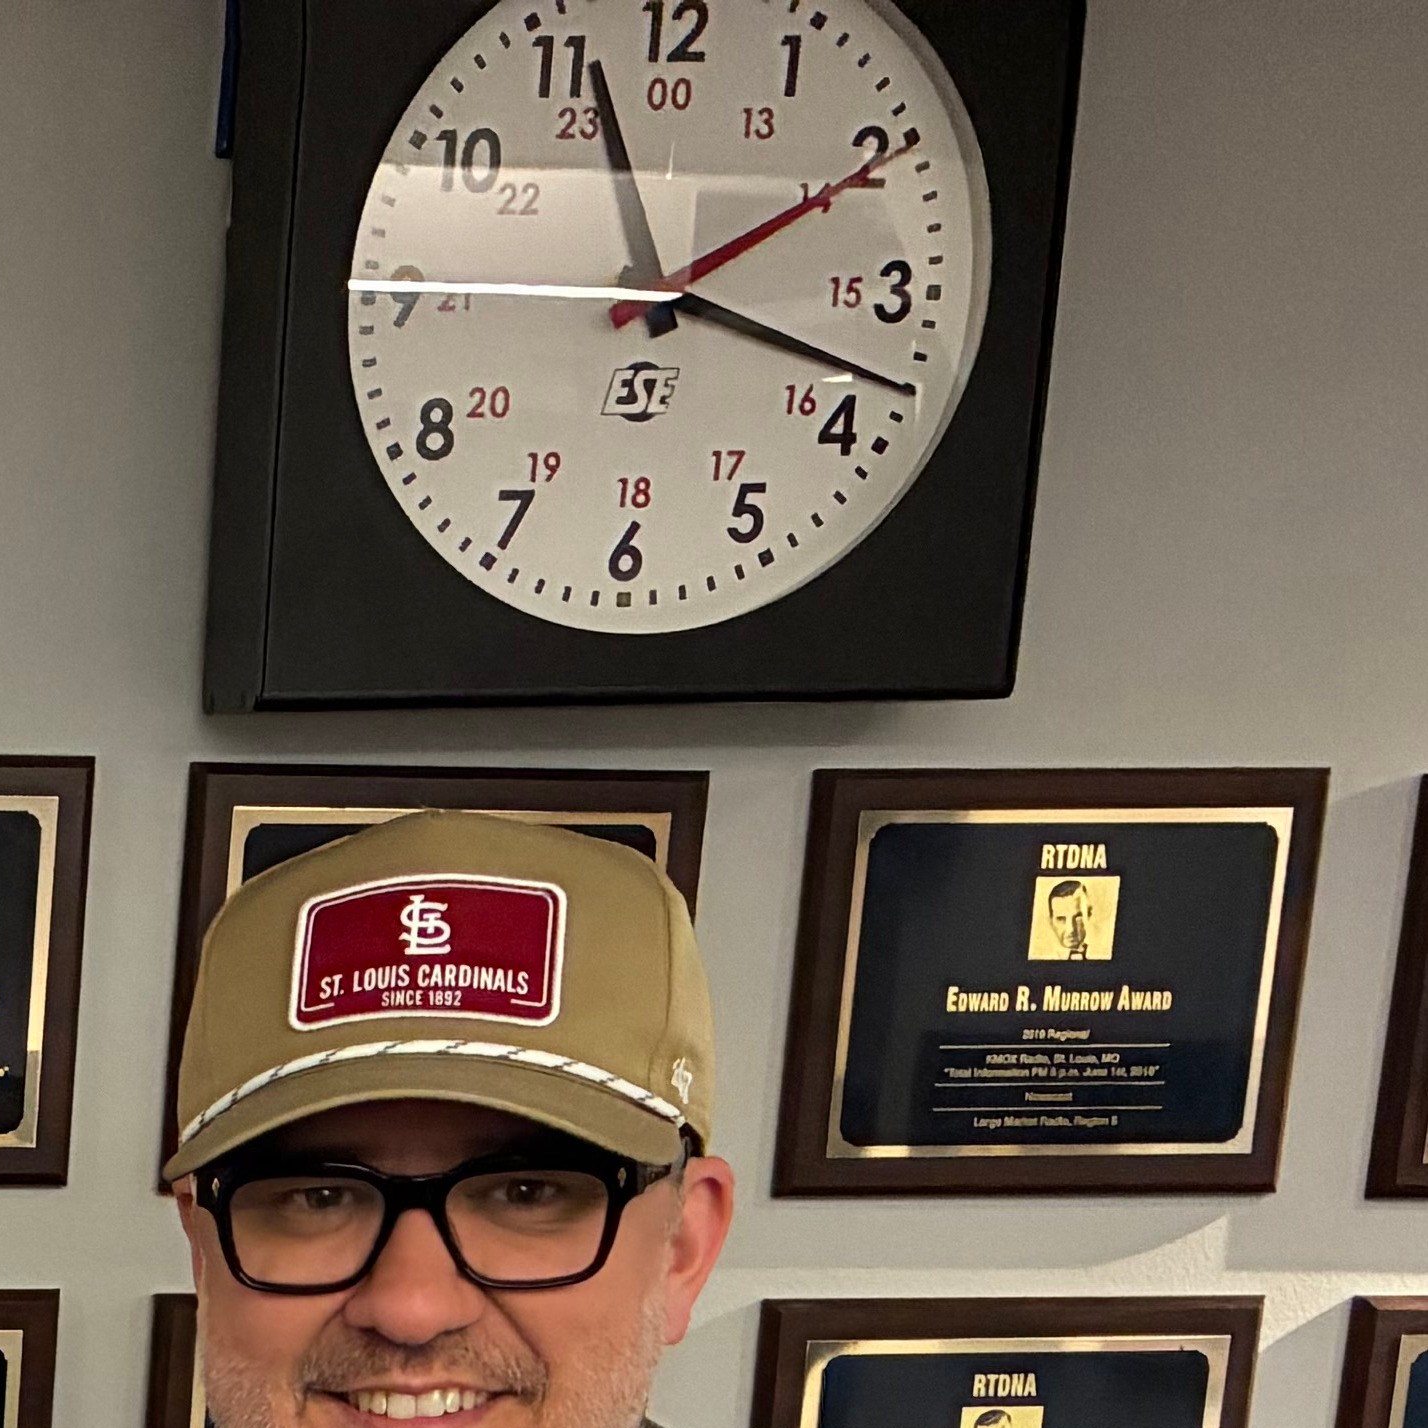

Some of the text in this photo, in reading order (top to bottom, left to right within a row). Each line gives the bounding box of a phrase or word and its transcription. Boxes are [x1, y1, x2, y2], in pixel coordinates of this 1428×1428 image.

[643, 0, 709, 63] 12
[532, 34, 586, 99] 11
[780, 34, 801, 97] 1
[647, 77, 692, 111] 00
[555, 106, 599, 140] 23
[743, 107, 775, 140] 13
[435, 127, 502, 193] 10
[852, 126, 889, 189] 2
[497, 182, 539, 215] 22
[390, 265, 425, 328] 9
[830, 277, 863, 308] 15
[874, 260, 912, 324] 3
[466, 386, 510, 419] 20
[785, 384, 816, 416] 16
[416, 397, 454, 461] 8
[818, 394, 857, 456] 4
[528, 451, 561, 483] 19
[712, 450, 746, 481] 17
[617, 476, 651, 509] 18
[497, 489, 535, 551] 7
[726, 482, 767, 543] 5
[608, 520, 643, 582] 6
[1041, 844, 1107, 869] RTDNA
[319, 964, 529, 999] ST. LOUIS CARDINALS
[381, 990, 462, 1006] SINCE 1892
[1015, 986, 1037, 1012] R.
[972, 1373, 1037, 1397] RTDNA
